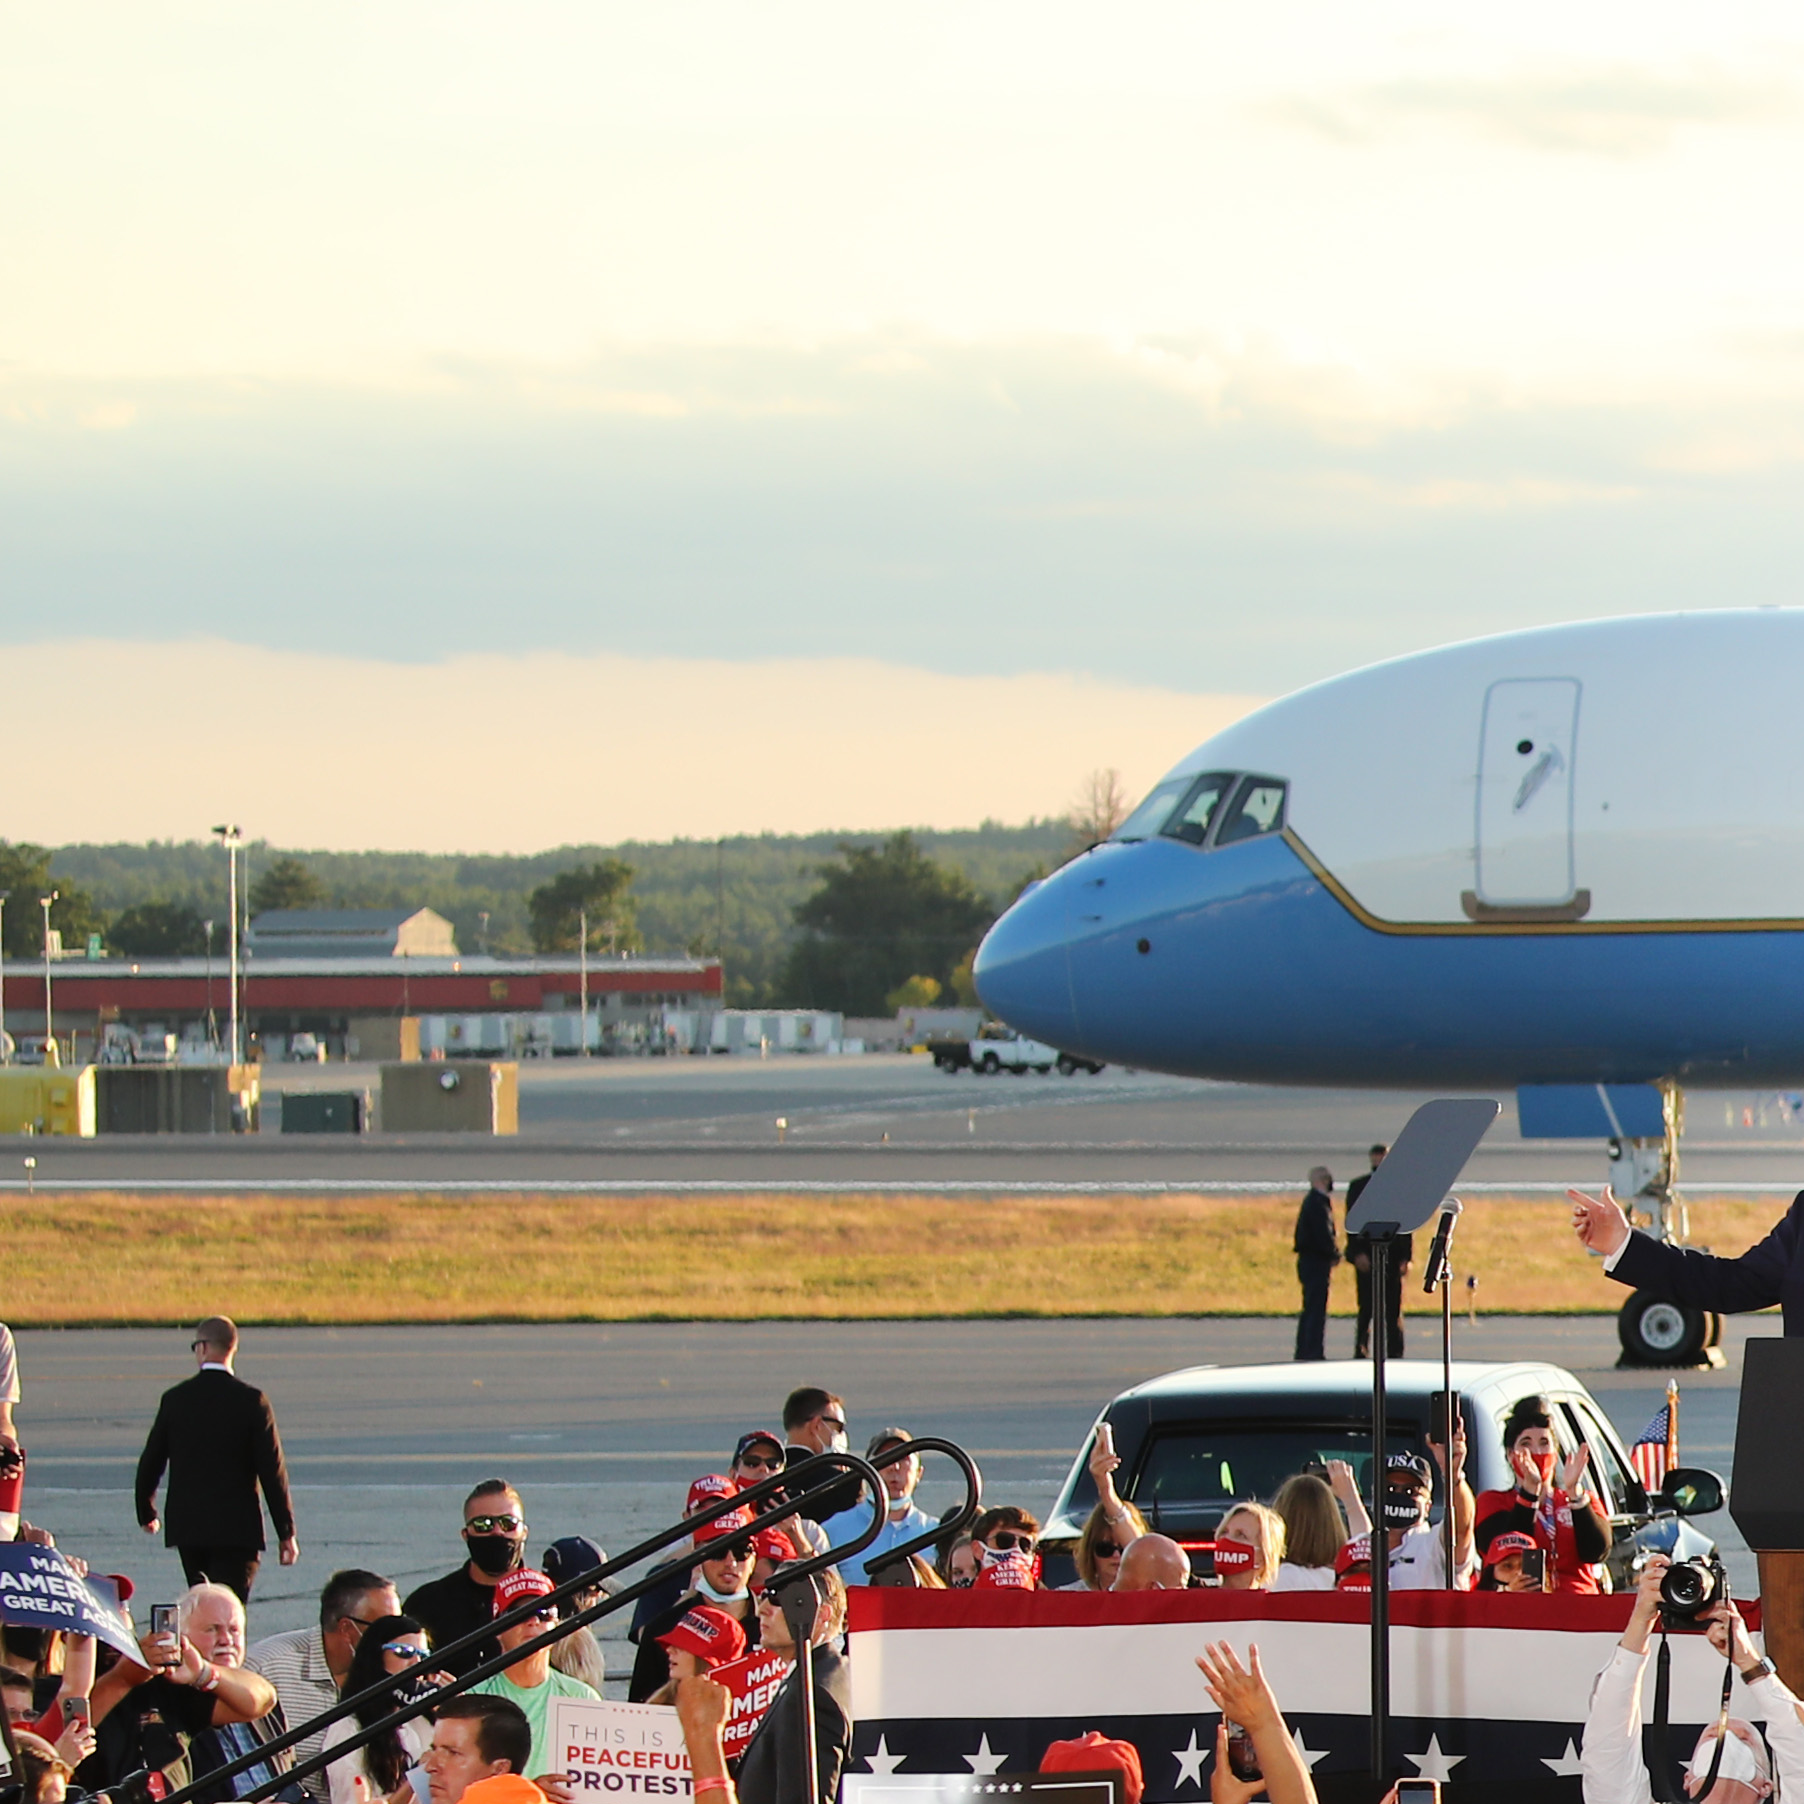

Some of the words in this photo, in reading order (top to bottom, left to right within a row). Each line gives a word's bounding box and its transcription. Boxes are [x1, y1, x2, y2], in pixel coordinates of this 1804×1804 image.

[1388, 1454, 1419, 1471] USA
[3, 1594, 76, 1617] GREAT
[568, 1723, 626, 1744] THIS
[641, 1730, 664, 1746] IS
[567, 1745, 693, 1771] PEACEFUL
